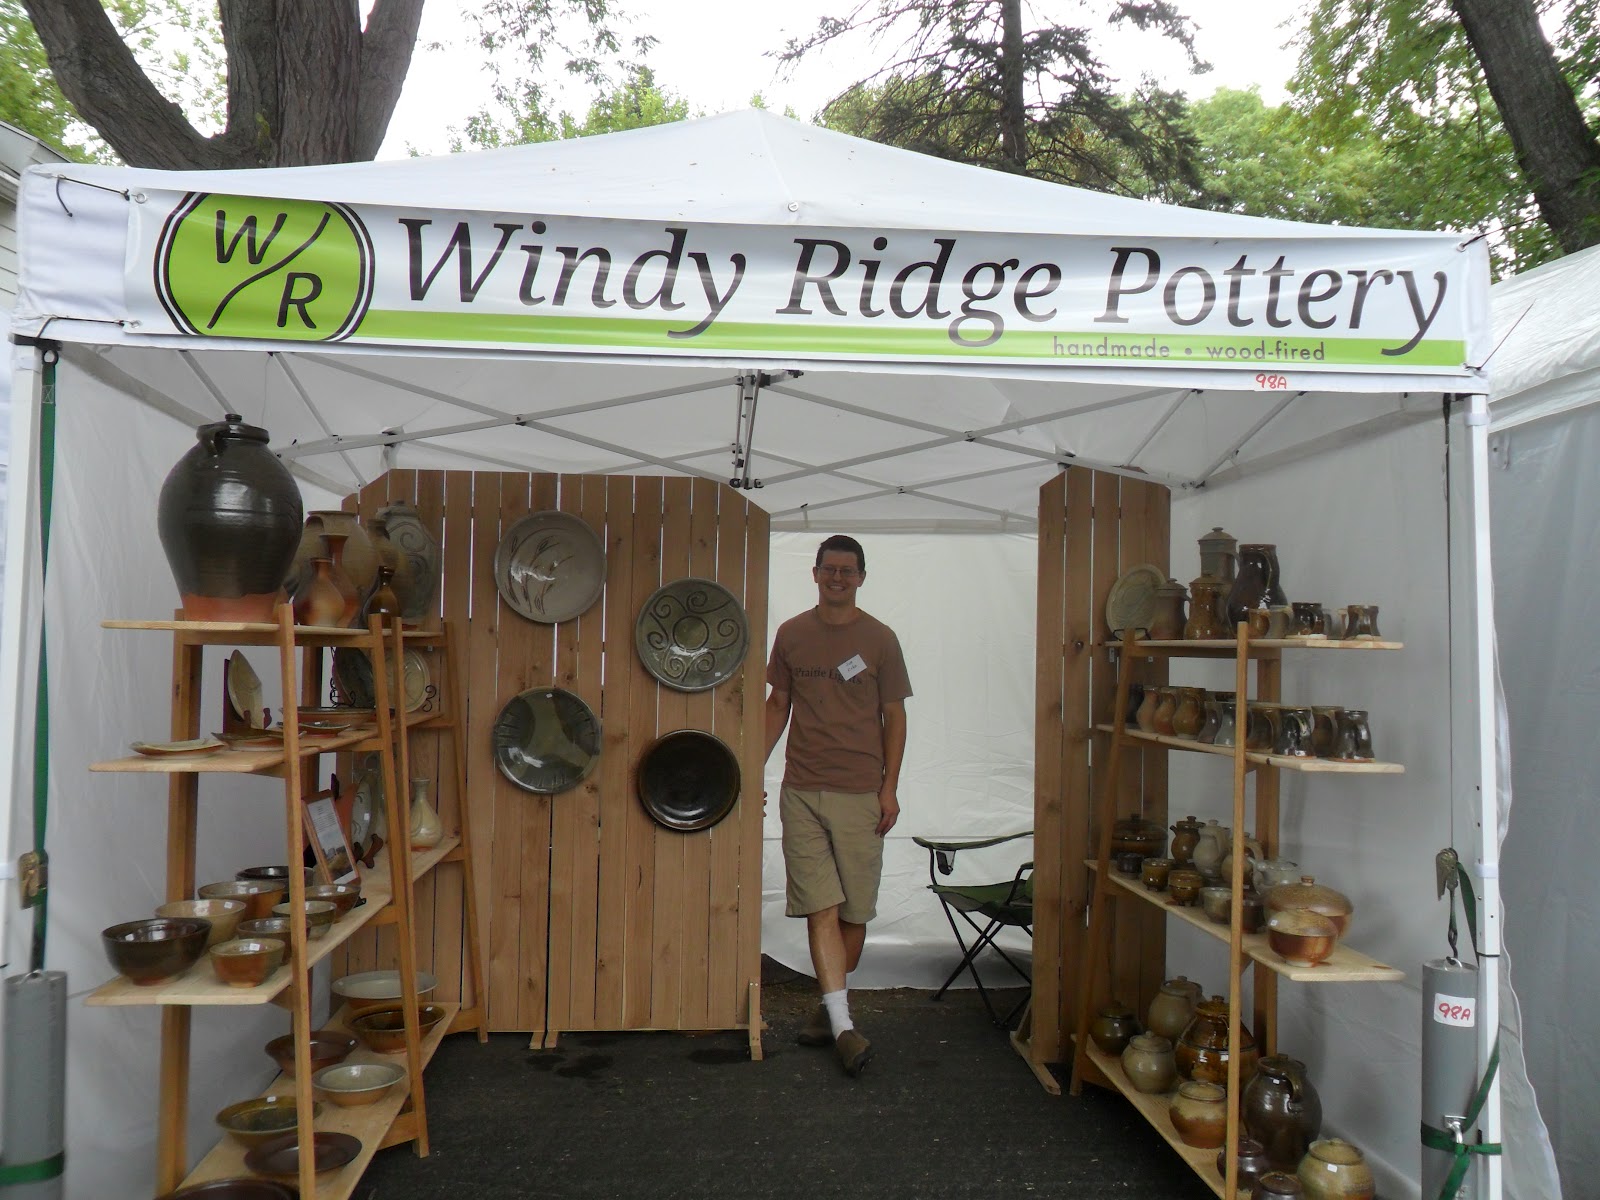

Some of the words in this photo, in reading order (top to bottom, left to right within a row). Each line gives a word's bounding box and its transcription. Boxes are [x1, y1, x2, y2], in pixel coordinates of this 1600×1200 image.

[215, 210, 287, 264] W
[399, 217, 745, 338] Windy
[776, 236, 1062, 347] Ridge
[1094, 246, 1448, 357] Pottery
[277, 272, 322, 330] R
[1053, 336, 1170, 358] handmade
[1206, 340, 1325, 360] wood-fired
[1254, 373, 1287, 390] 98A
[796, 666, 826, 678] Prairie
[829, 669, 862, 684] Ligts
[1438, 1002, 1471, 1021] 98A
